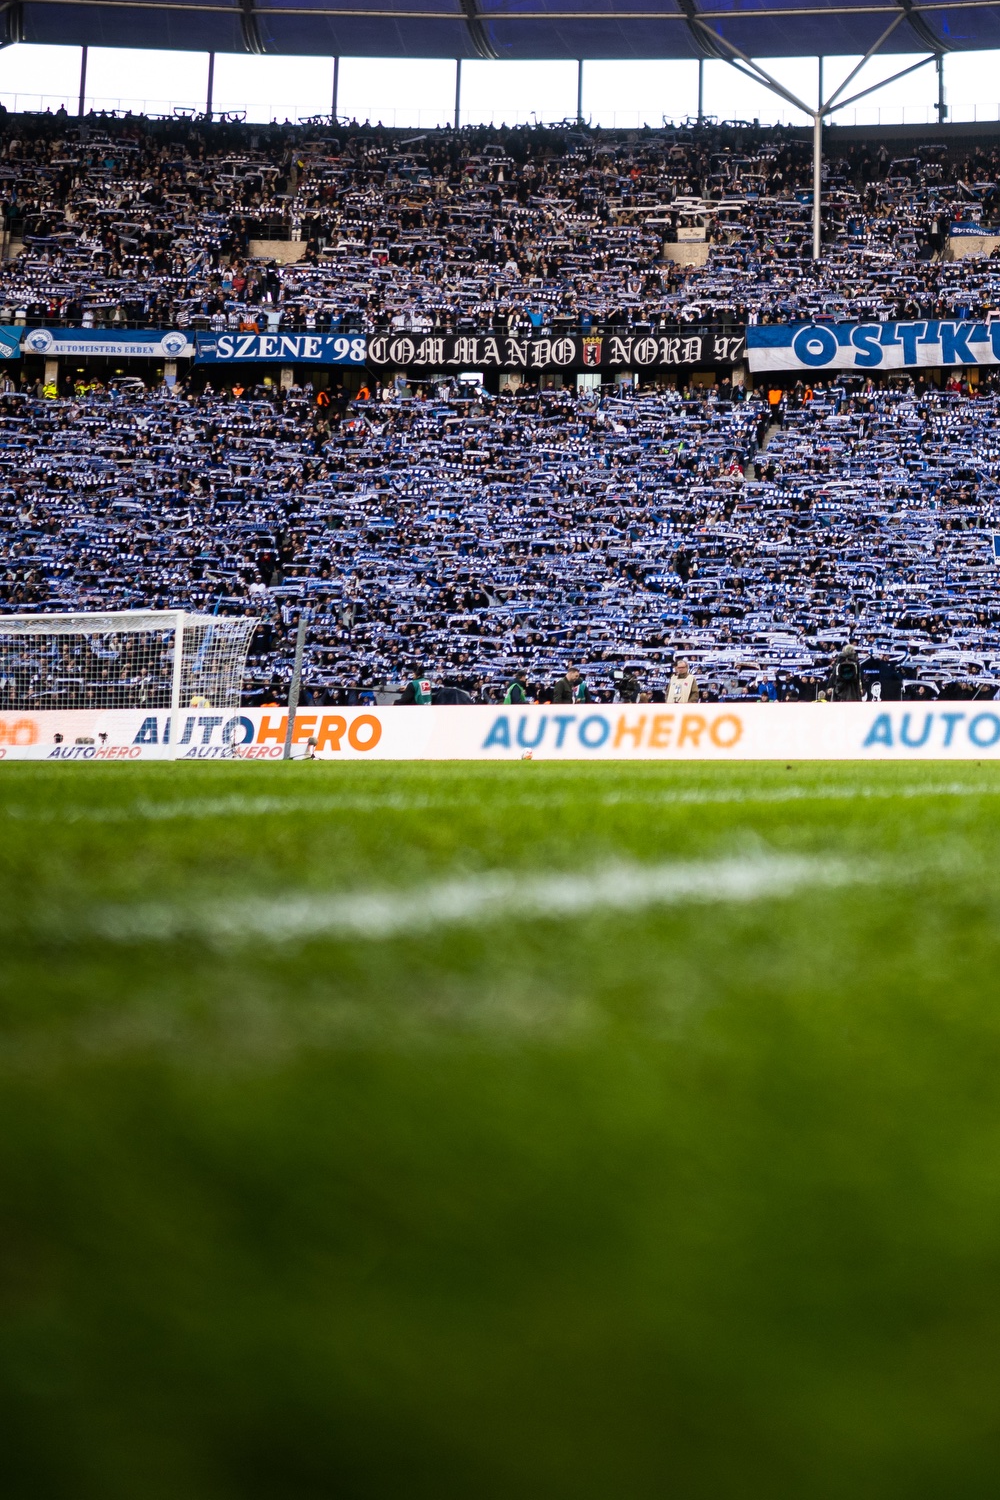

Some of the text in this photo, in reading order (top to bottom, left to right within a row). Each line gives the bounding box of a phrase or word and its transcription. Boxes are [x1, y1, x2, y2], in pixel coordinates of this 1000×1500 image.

[53, 344, 155, 354] AUTOMEISTERS ERBEN
[608, 336, 702, 365] NORD
[132, 713, 383, 752] AUTOHERO
[481, 713, 745, 751] AUTOHERO
[47, 746, 142, 759] AUTOHERO
[186, 746, 284, 759] AUTOHERO
